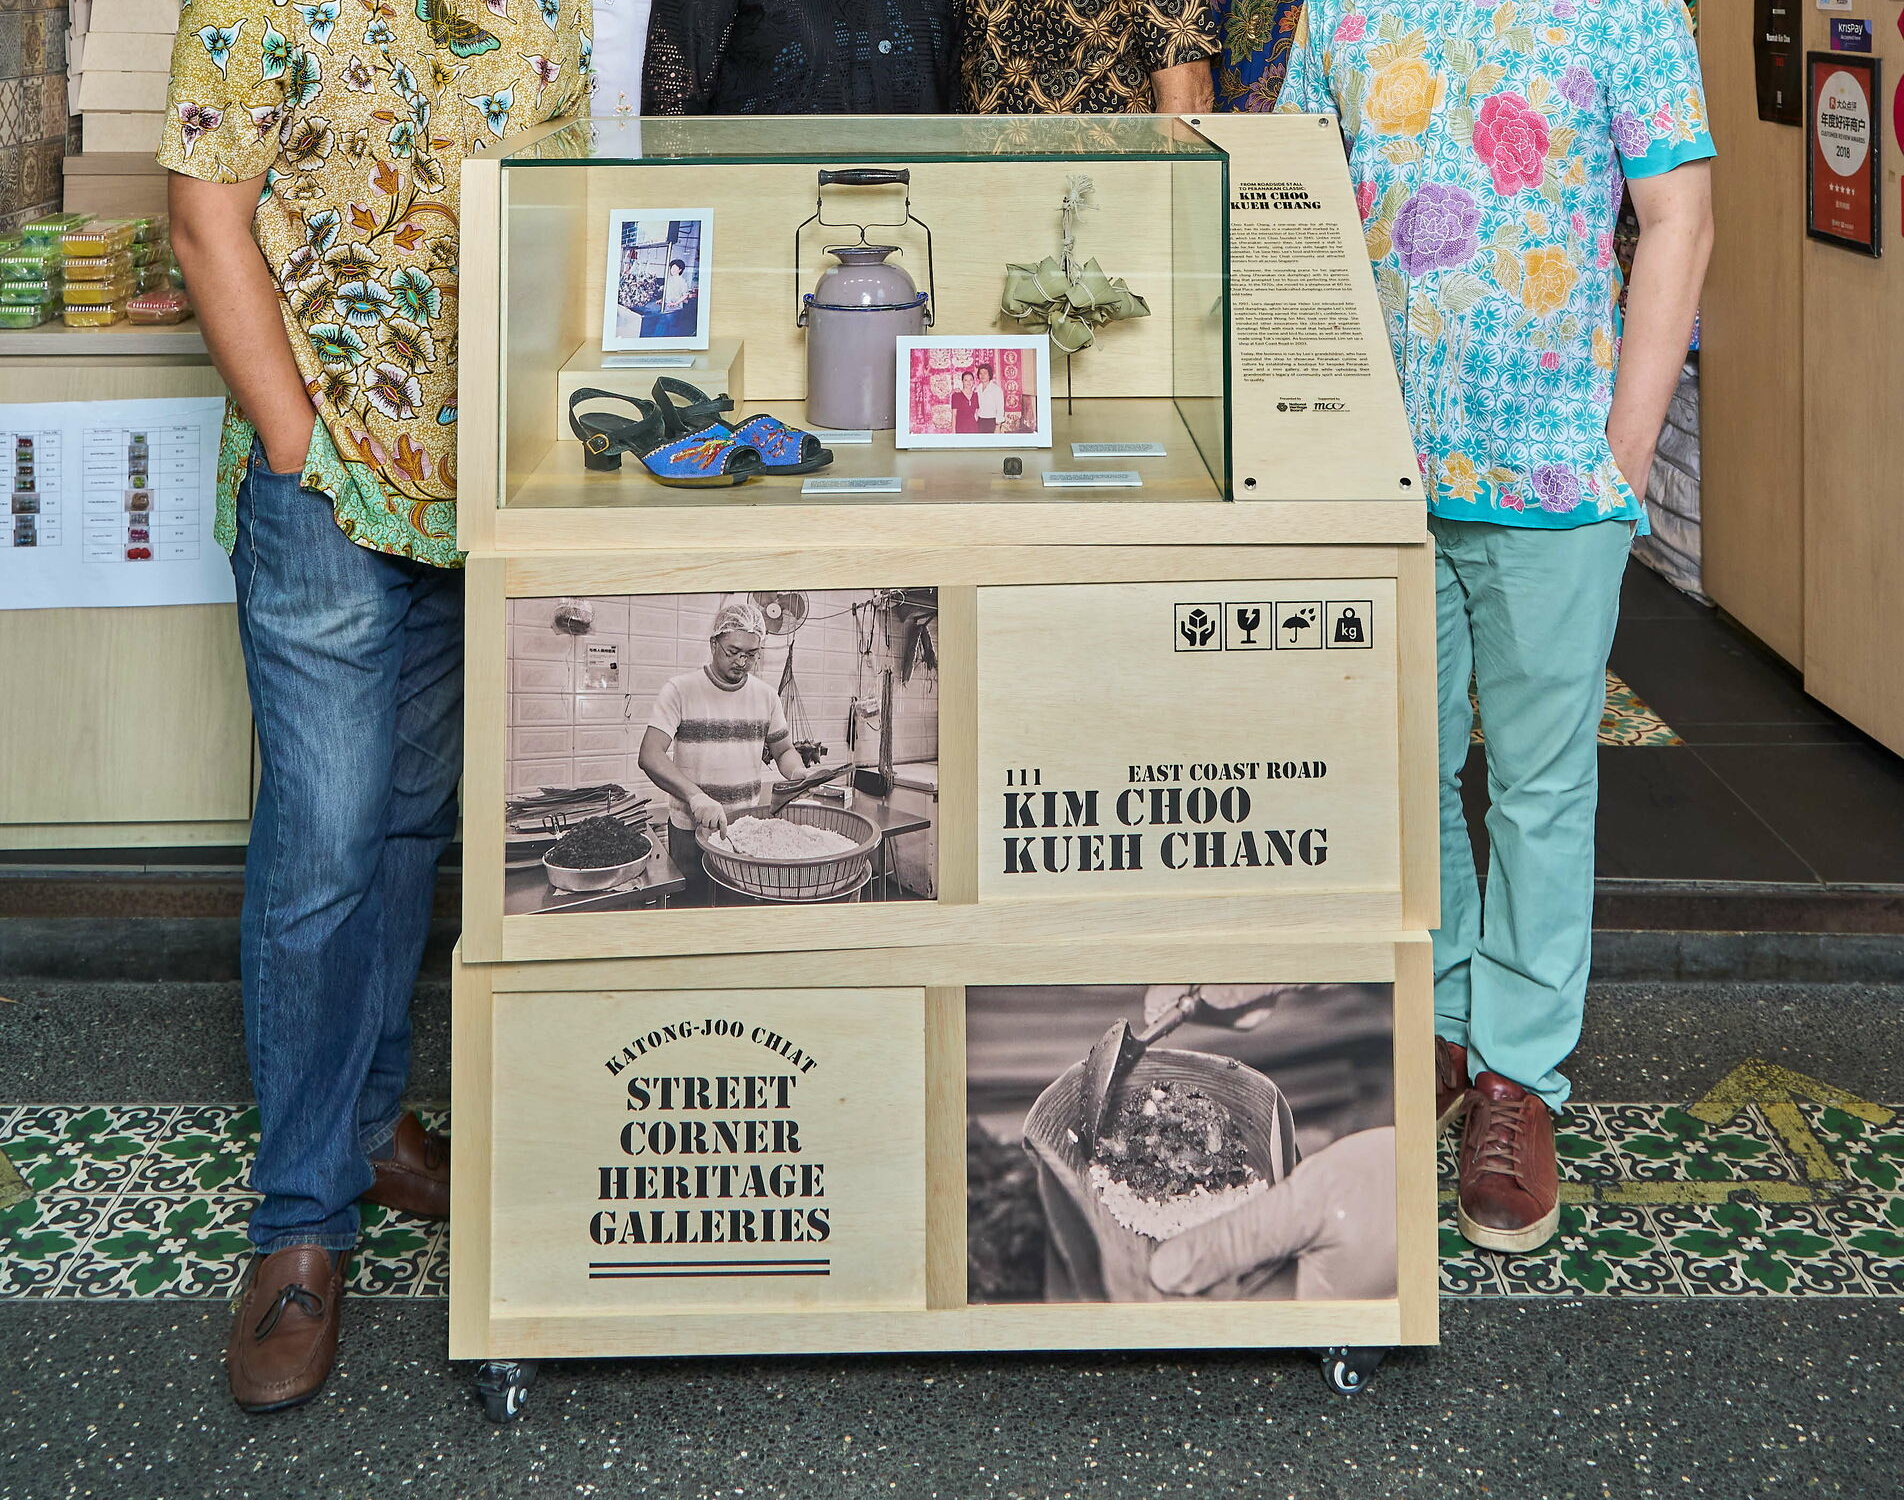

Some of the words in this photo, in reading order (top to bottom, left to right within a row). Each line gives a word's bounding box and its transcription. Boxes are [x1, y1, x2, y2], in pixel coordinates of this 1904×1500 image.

[1837, 99, 1857, 111] 大众点评
[1821, 113, 1865, 133] 年度好评商户
[1821, 130, 1837, 139] CUSTOMER
[1851, 135, 1865, 144] AWARDS
[1836, 145, 1850, 159] 2018
[1231, 201, 1270, 210] KUEH
[1273, 201, 1321, 210] CHANG
[1342, 622, 1357, 639] kg
[1006, 768, 1041, 786] 111
[1128, 764, 1184, 784] EAST
[1189, 762, 1260, 782] COAST
[1266, 760, 1327, 780] ROAD
[1002, 789, 1100, 830] KIM
[1116, 786, 1251, 826] CHOO
[1002, 834, 1144, 874] KUEH
[1160, 827, 1328, 871] CHANG
[604, 1019, 745, 1077] KATONG-JOO
[751, 1026, 818, 1074] CHIAT
[627, 1076, 797, 1111] STREET
[620, 1120, 802, 1156] CORNER
[598, 1164, 824, 1200] HERITAGE
[589, 1208, 831, 1245] GALLERIES
